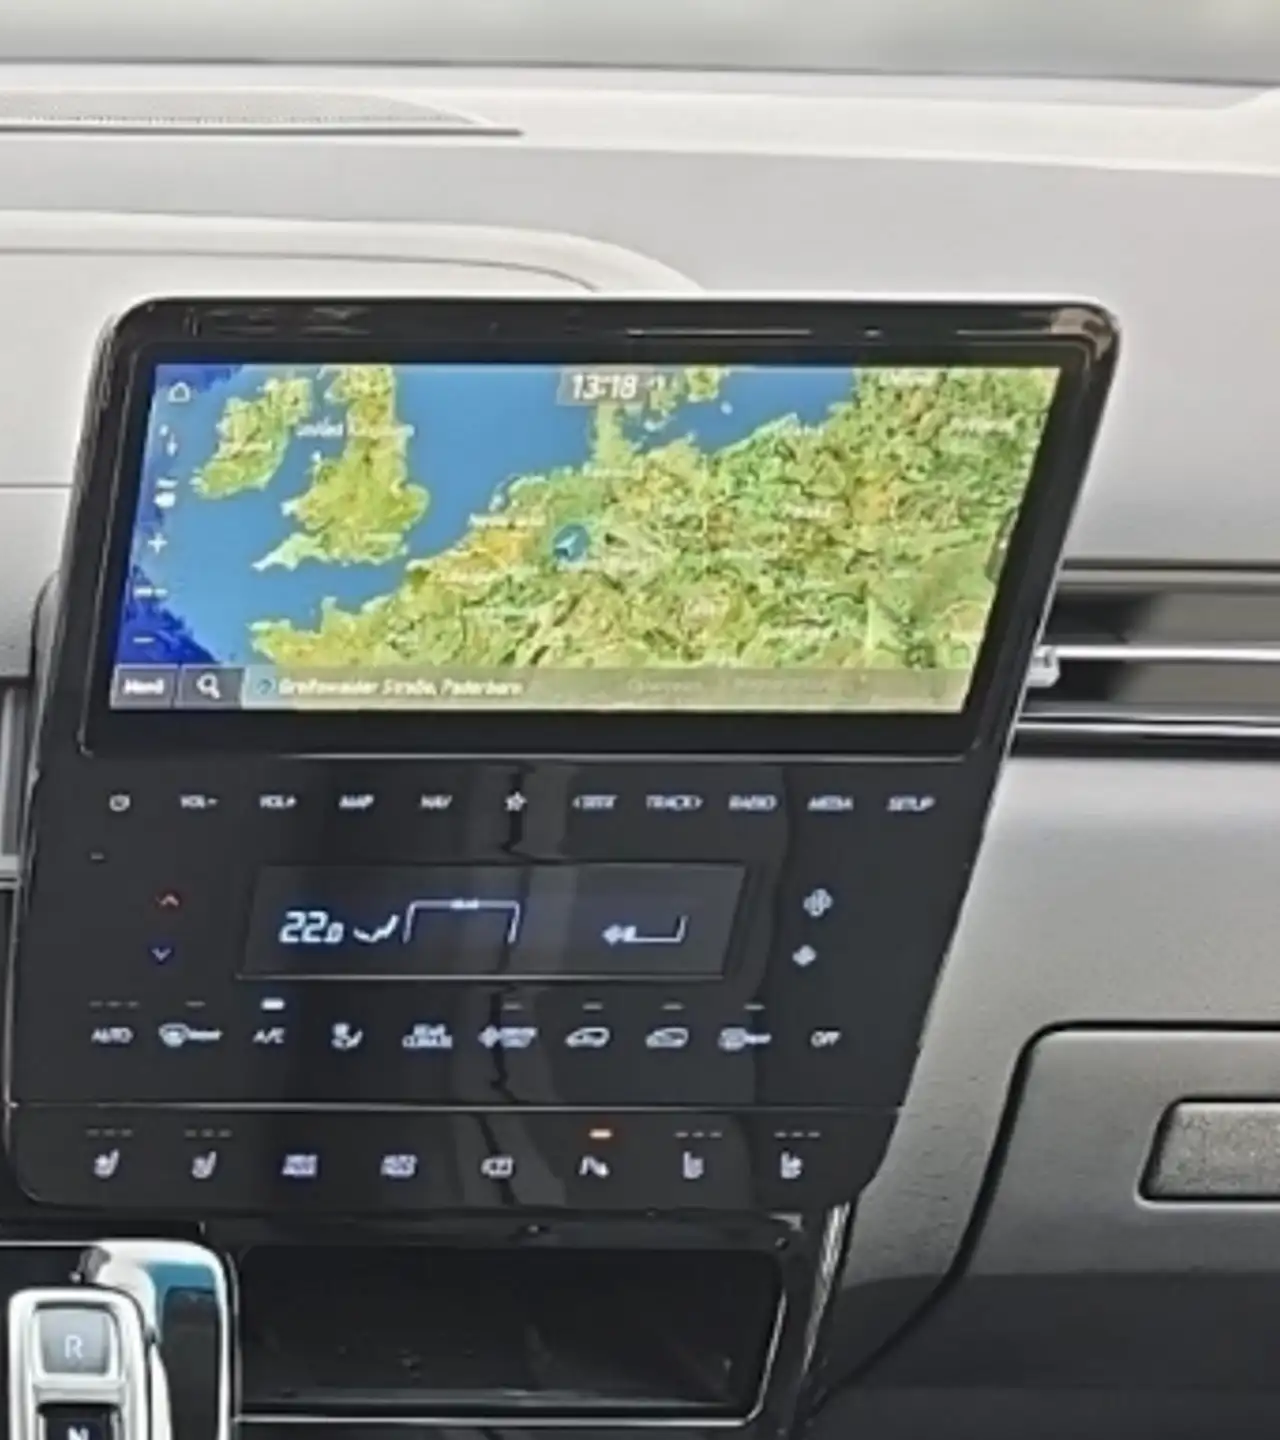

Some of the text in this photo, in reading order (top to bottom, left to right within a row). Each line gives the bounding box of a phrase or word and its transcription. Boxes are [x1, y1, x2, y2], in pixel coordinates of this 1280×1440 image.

[571, 373, 640, 400] 13:18
[728, 794, 779, 810] RADIO
[886, 795, 937, 812] SETUP
[91, 1027, 135, 1044] AUTO
[252, 1027, 286, 1045] A/C
[64, 1334, 84, 1359] R
